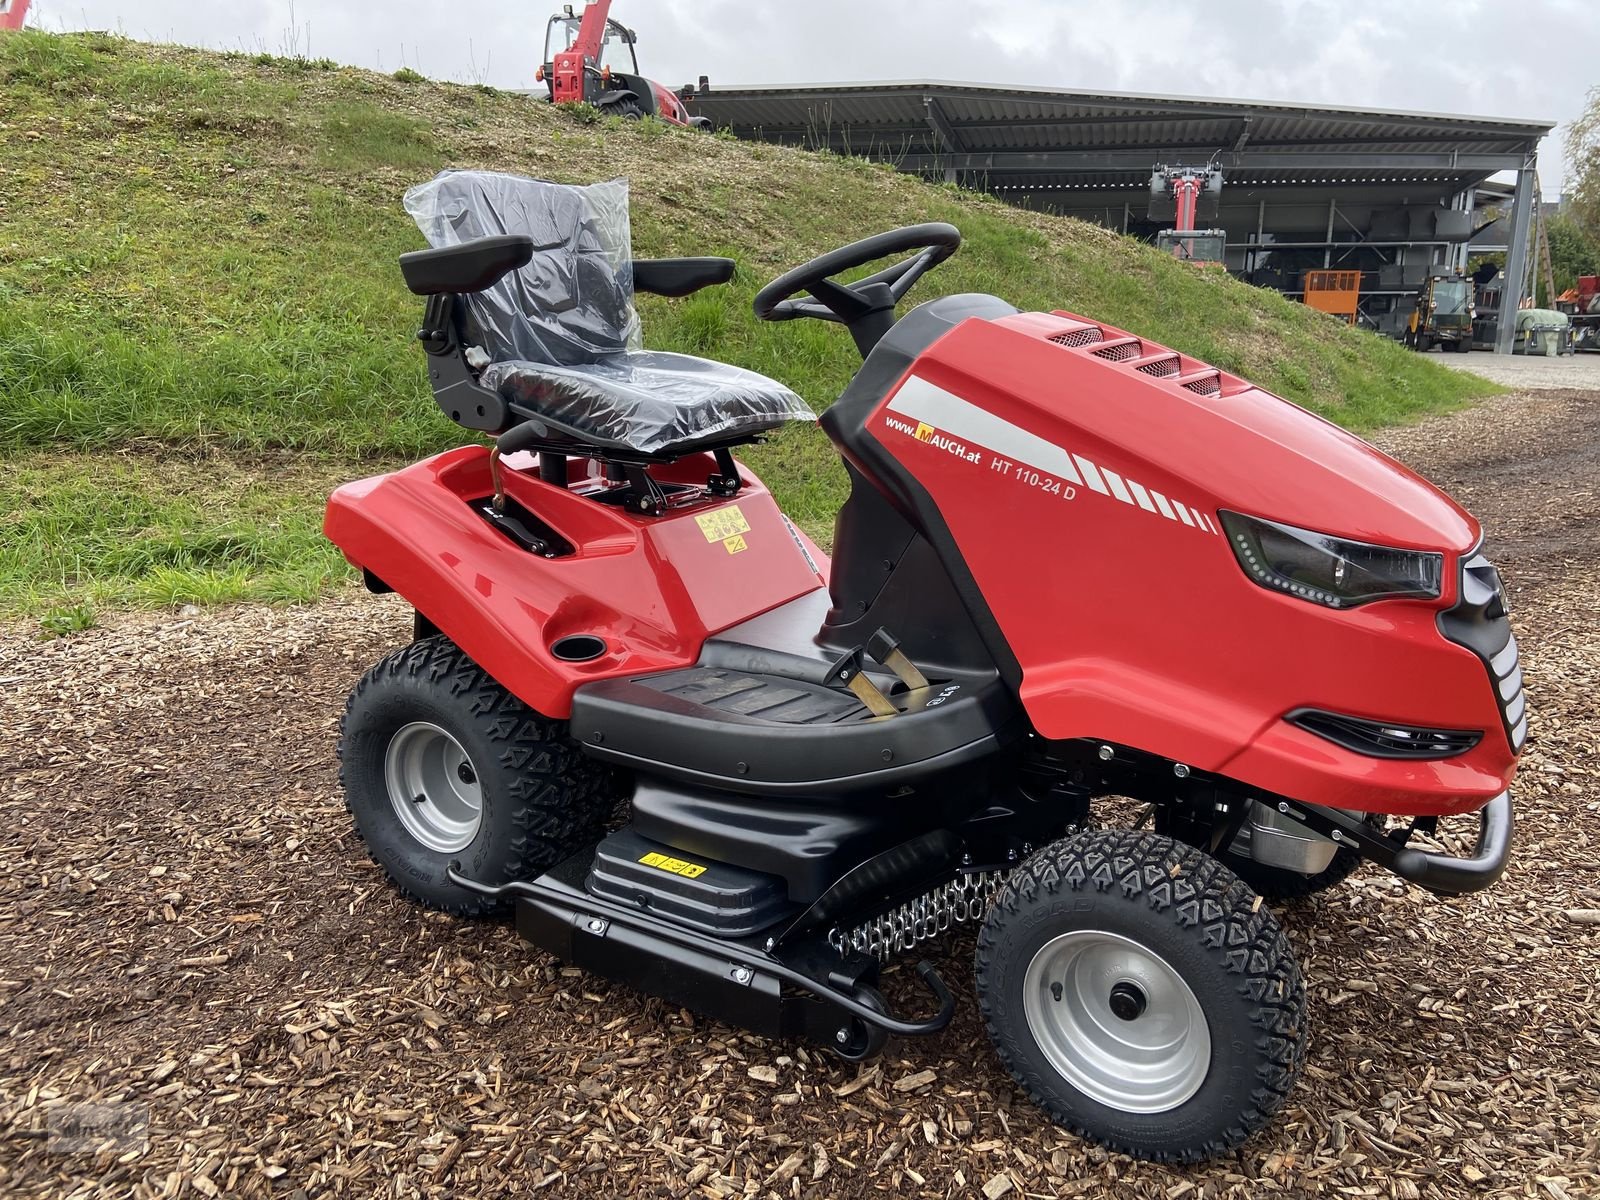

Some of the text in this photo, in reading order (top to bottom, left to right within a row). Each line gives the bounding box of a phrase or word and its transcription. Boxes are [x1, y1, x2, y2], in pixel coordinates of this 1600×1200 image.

[886, 417, 981, 464] www.MAUCH.at
[991, 458, 1076, 501] HT 110-24 D
